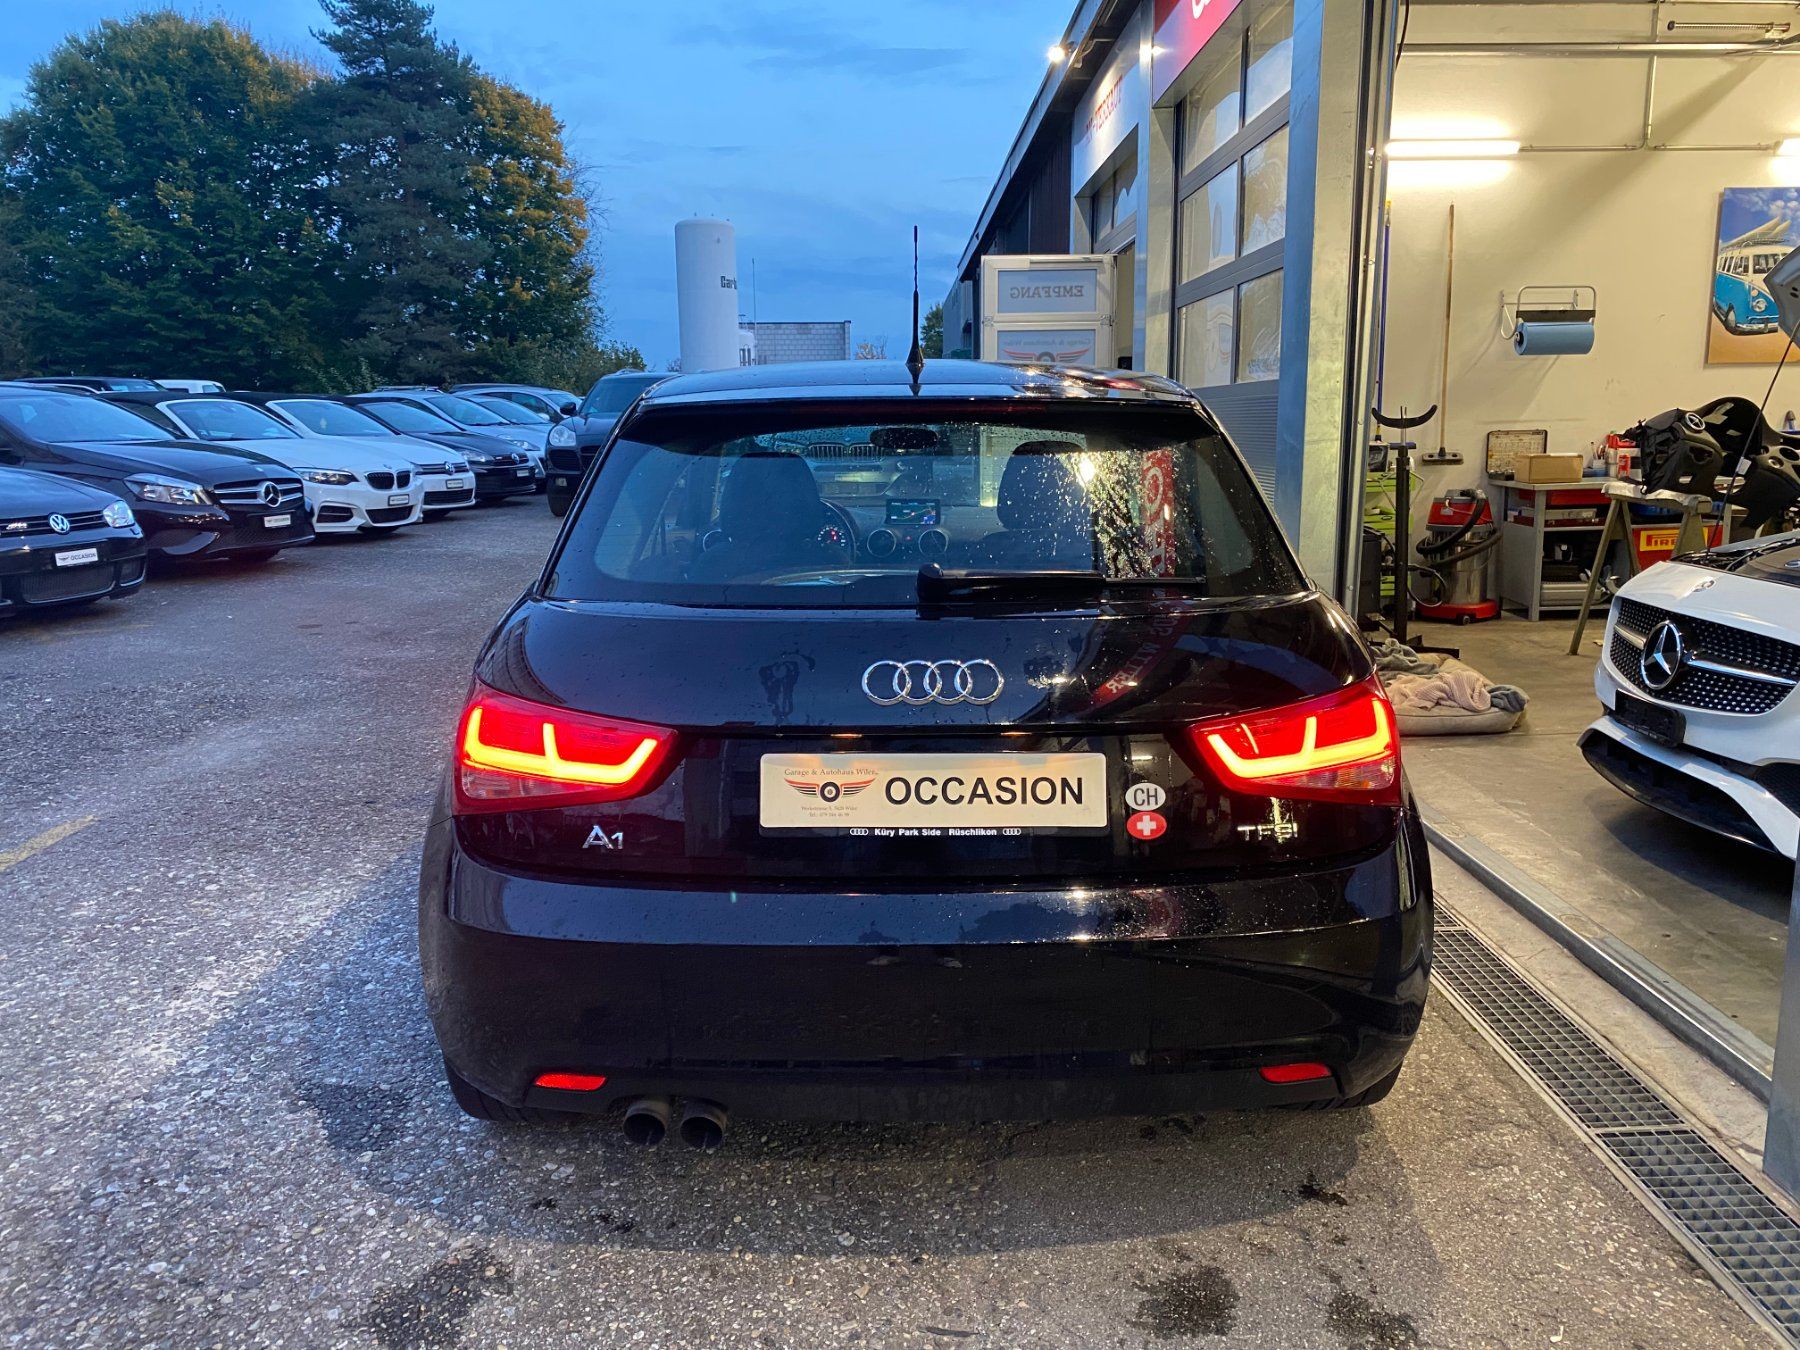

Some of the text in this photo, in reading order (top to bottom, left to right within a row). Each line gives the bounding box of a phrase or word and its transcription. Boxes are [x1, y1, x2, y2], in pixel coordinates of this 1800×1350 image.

[1646, 534, 1677, 547] PIRE
[784, 768, 810, 778] Garage
[811, 768, 818, 776] &
[819, 768, 854, 776] Autohaus
[885, 776, 1083, 806] OCCASION
[1133, 787, 1158, 807] CH
[582, 825, 623, 849] A1
[874, 828, 998, 837] Küry Park Side Rüschlikon
